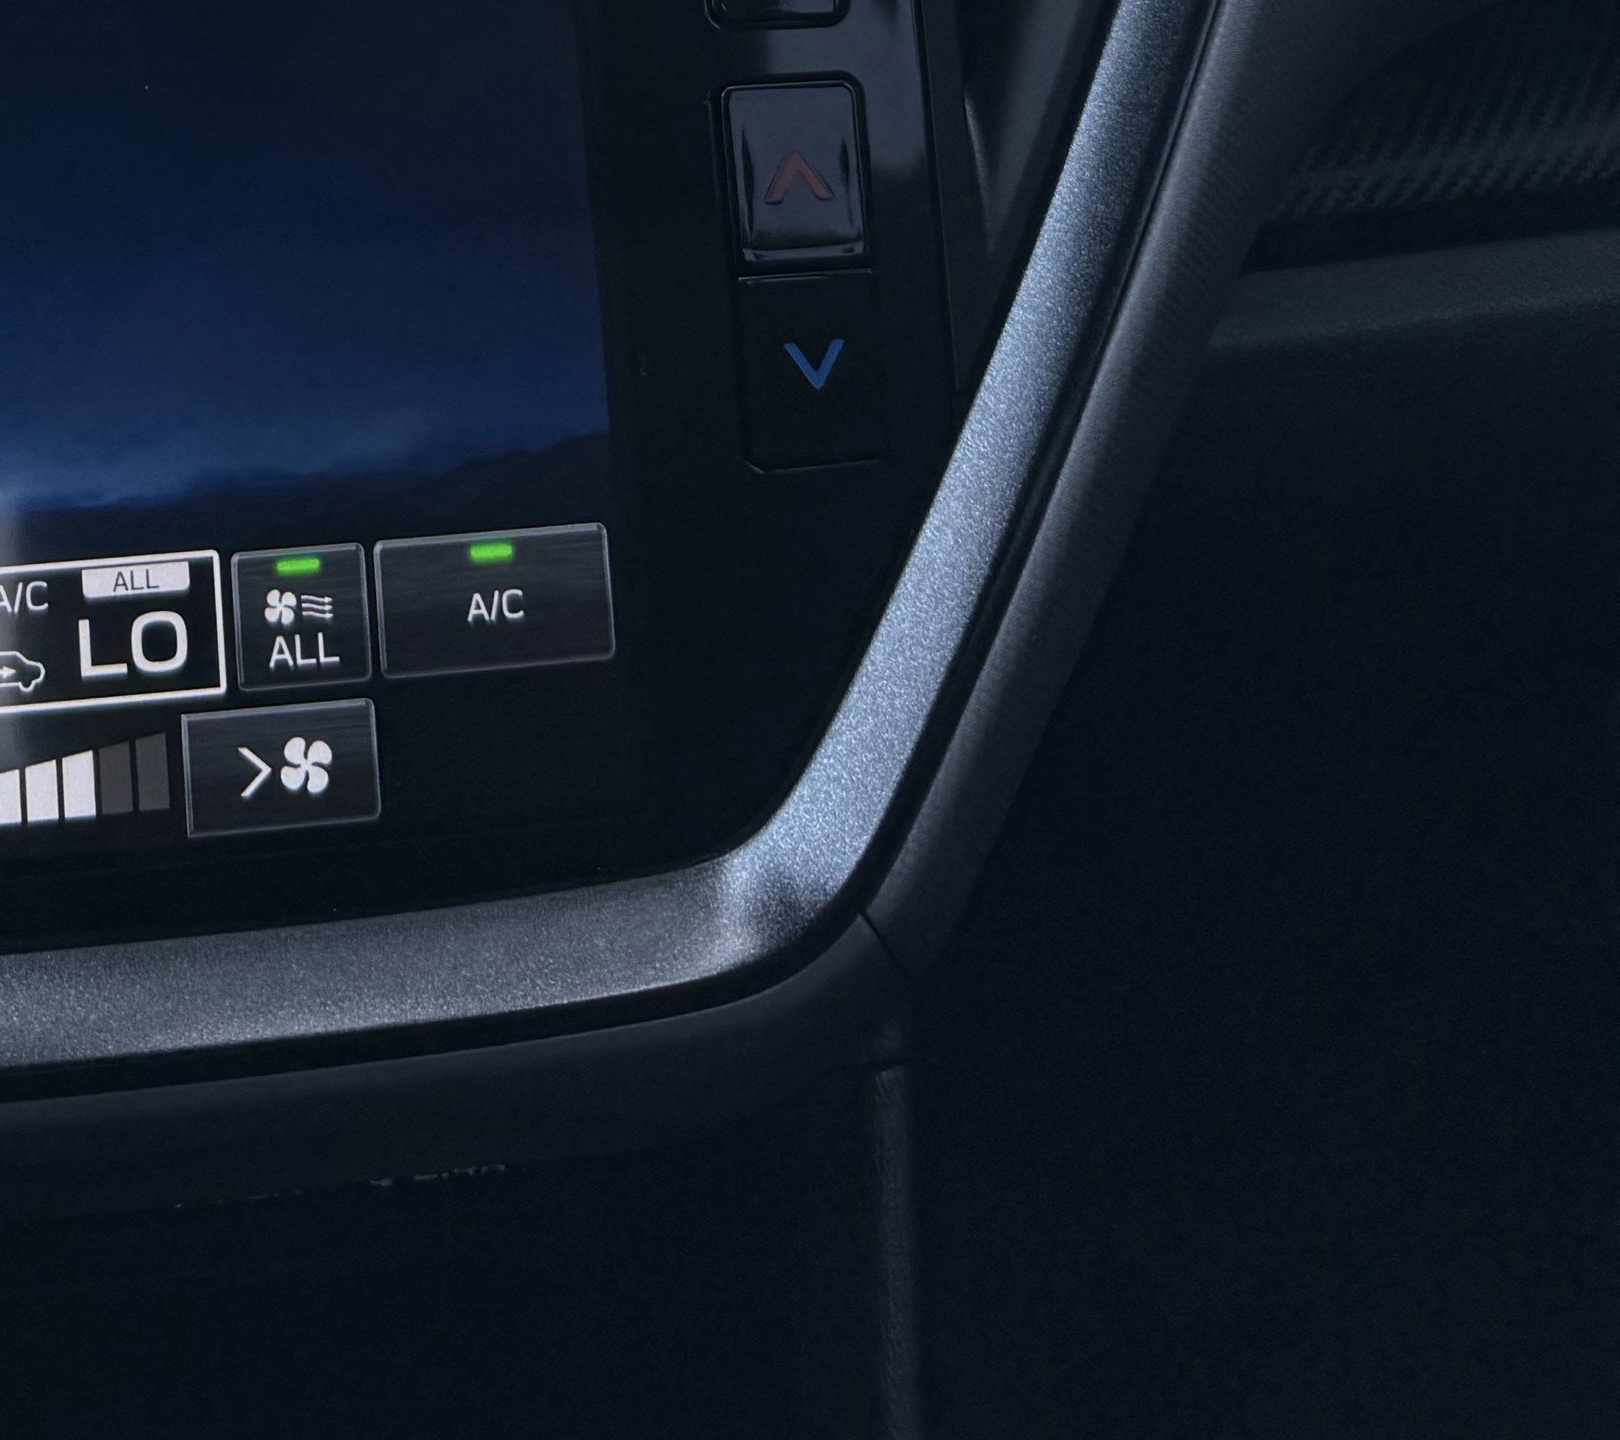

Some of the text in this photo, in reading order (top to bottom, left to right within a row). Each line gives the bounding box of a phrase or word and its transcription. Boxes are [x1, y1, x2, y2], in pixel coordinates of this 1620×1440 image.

[112, 569, 160, 593] ALL
[466, 588, 525, 622] A/C
[78, 610, 188, 678] LO
[268, 631, 340, 669] ALL
